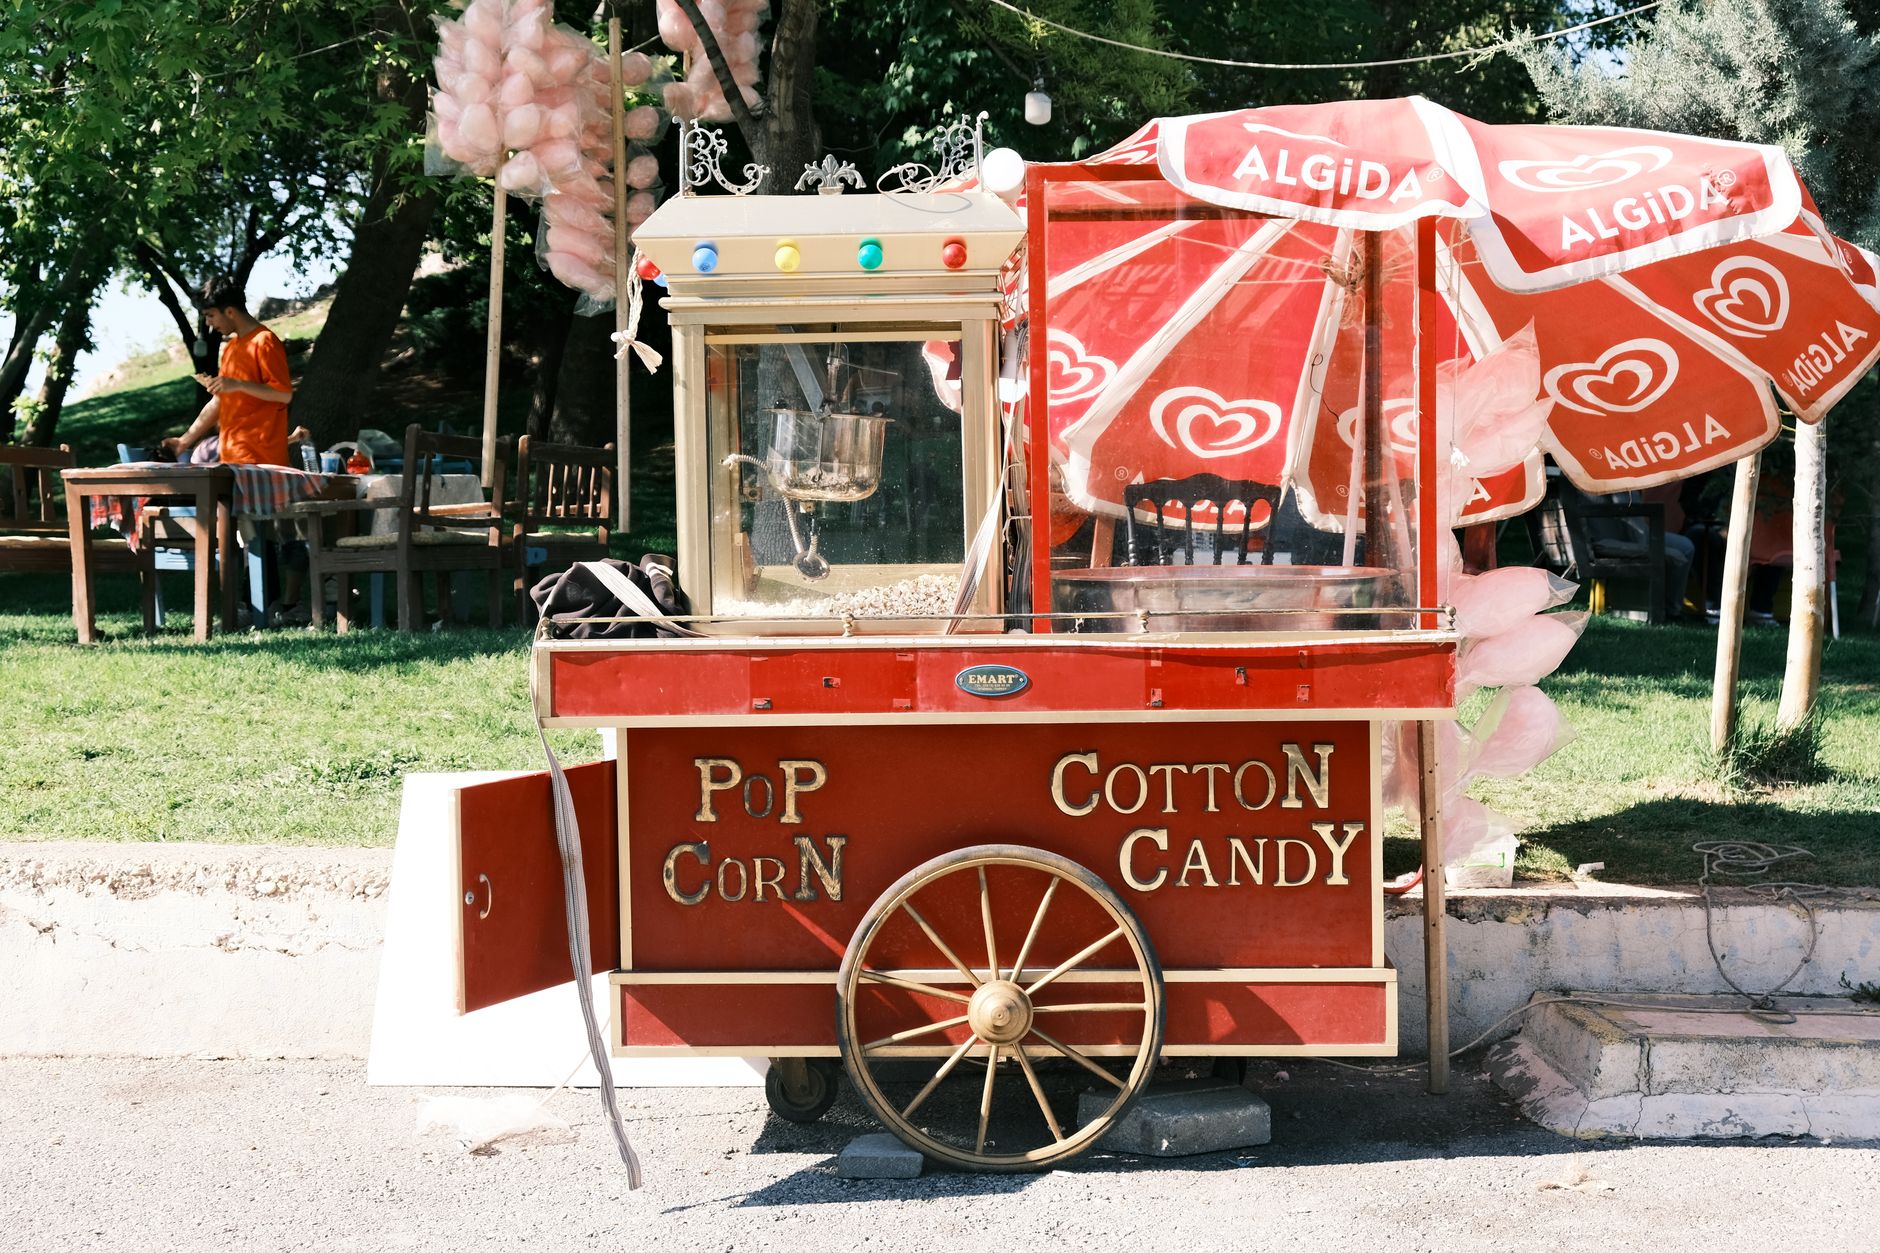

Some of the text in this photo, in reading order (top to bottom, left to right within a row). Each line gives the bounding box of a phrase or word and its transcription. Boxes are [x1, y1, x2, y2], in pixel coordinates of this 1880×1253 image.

[968, 674, 1015, 684] EMART
[1050, 743, 1335, 817] COTTON
[662, 834, 847, 906] CORN
[1118, 821, 1365, 892] CANDY
